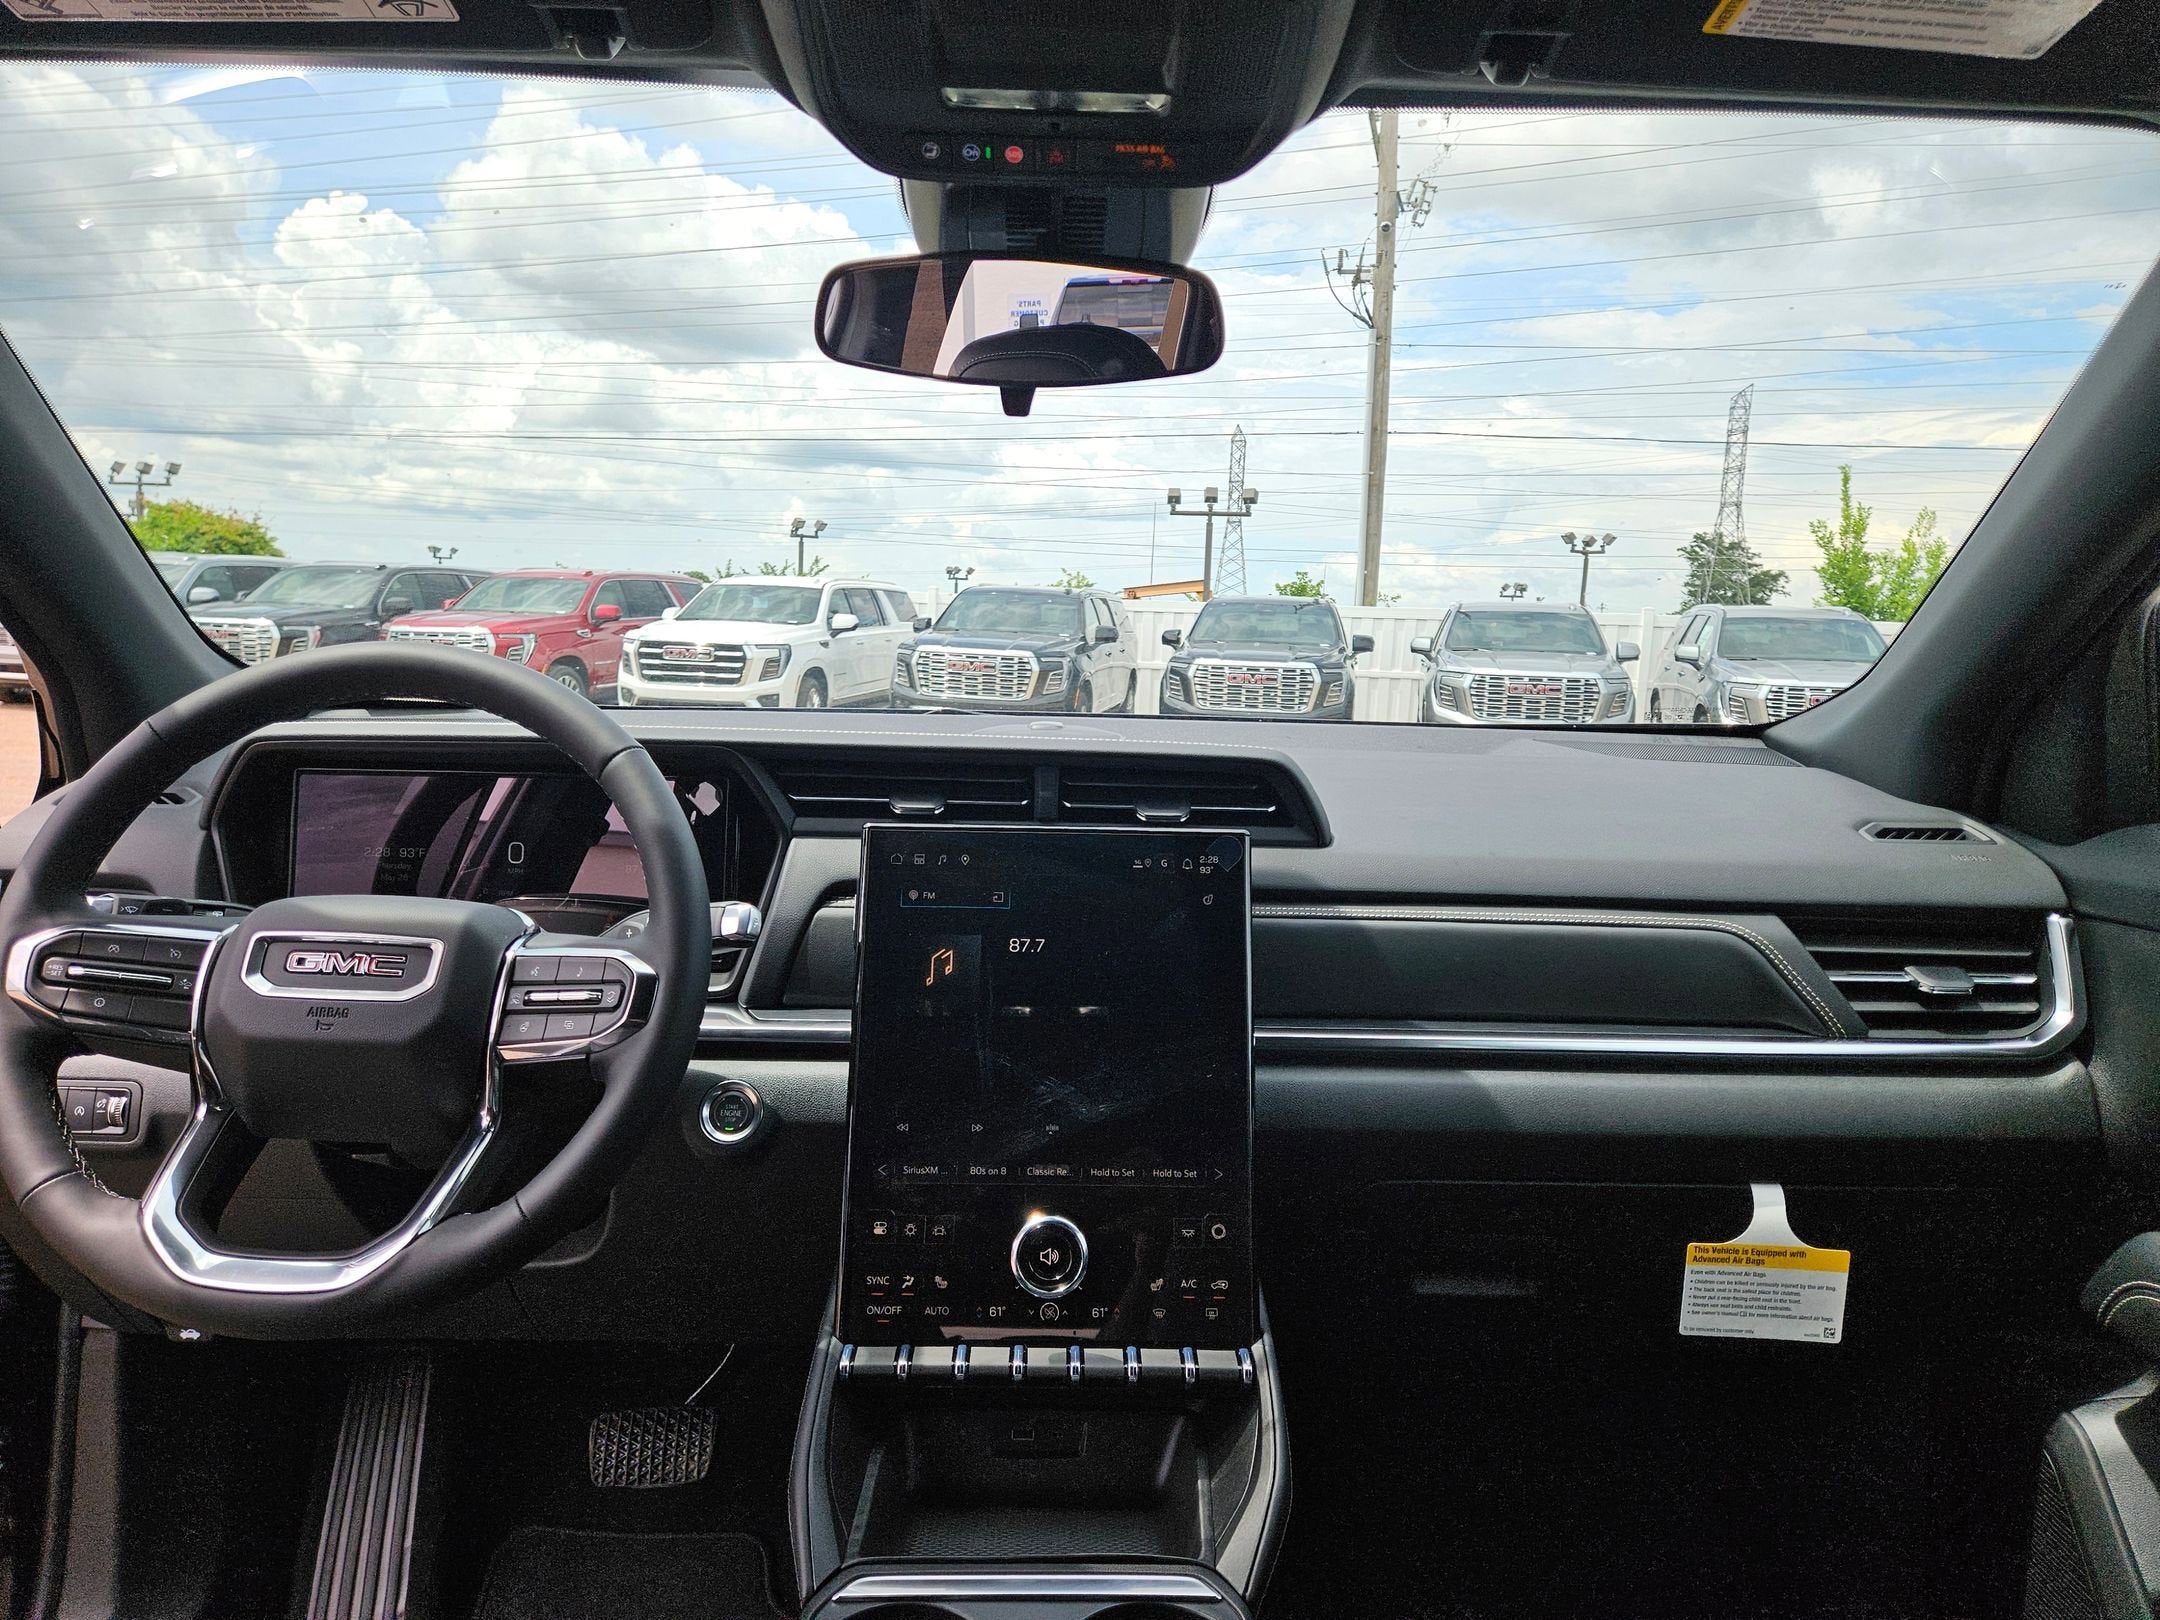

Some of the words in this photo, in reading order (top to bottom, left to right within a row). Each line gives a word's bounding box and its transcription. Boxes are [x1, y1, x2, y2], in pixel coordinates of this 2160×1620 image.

[948, 660, 995, 672] GMC
[1228, 673, 1278, 685] GMC
[1508, 683, 1561, 696] GMC
[1199, 856, 1219, 864] 2:28
[922, 891, 936, 900] FM
[1008, 938, 1046, 954] 87.7
[286, 951, 408, 977] GMC
[306, 1006, 350, 1018] AIRBAG
[720, 1109, 742, 1117] ENGINE
[903, 1166, 939, 1175] SiriusXM
[969, 1166, 986, 1175] 80s
[1000, 1167, 1007, 1175] 8
[1026, 1167, 1054, 1176] Classic
[1090, 1168, 1110, 1177] Hold
[1111, 1169, 1120, 1177] to
[1121, 1168, 1135, 1177] Set
[1152, 1169, 1172, 1178] Hold
[1173, 1170, 1182, 1178] to
[1183, 1169, 1197, 1178] Set
[1694, 1246, 1709, 1254] This
[1712, 1247, 1740, 1255] Vehicle
[1751, 1248, 1788, 1257] Equipped
[1789, 1250, 1807, 1258] with
[1693, 1255, 1730, 1263] Advanced
[1732, 1256, 1743, 1264] Air
[1745, 1257, 1766, 1266] Bags
[866, 1275, 890, 1285] SYNC
[1180, 1279, 1197, 1288] A/C
[866, 1306, 903, 1315] ON/OFF
[924, 1307, 950, 1316] AUTO
[989, 1306, 1006, 1317] 61°
[1092, 1307, 1109, 1318] 61°
